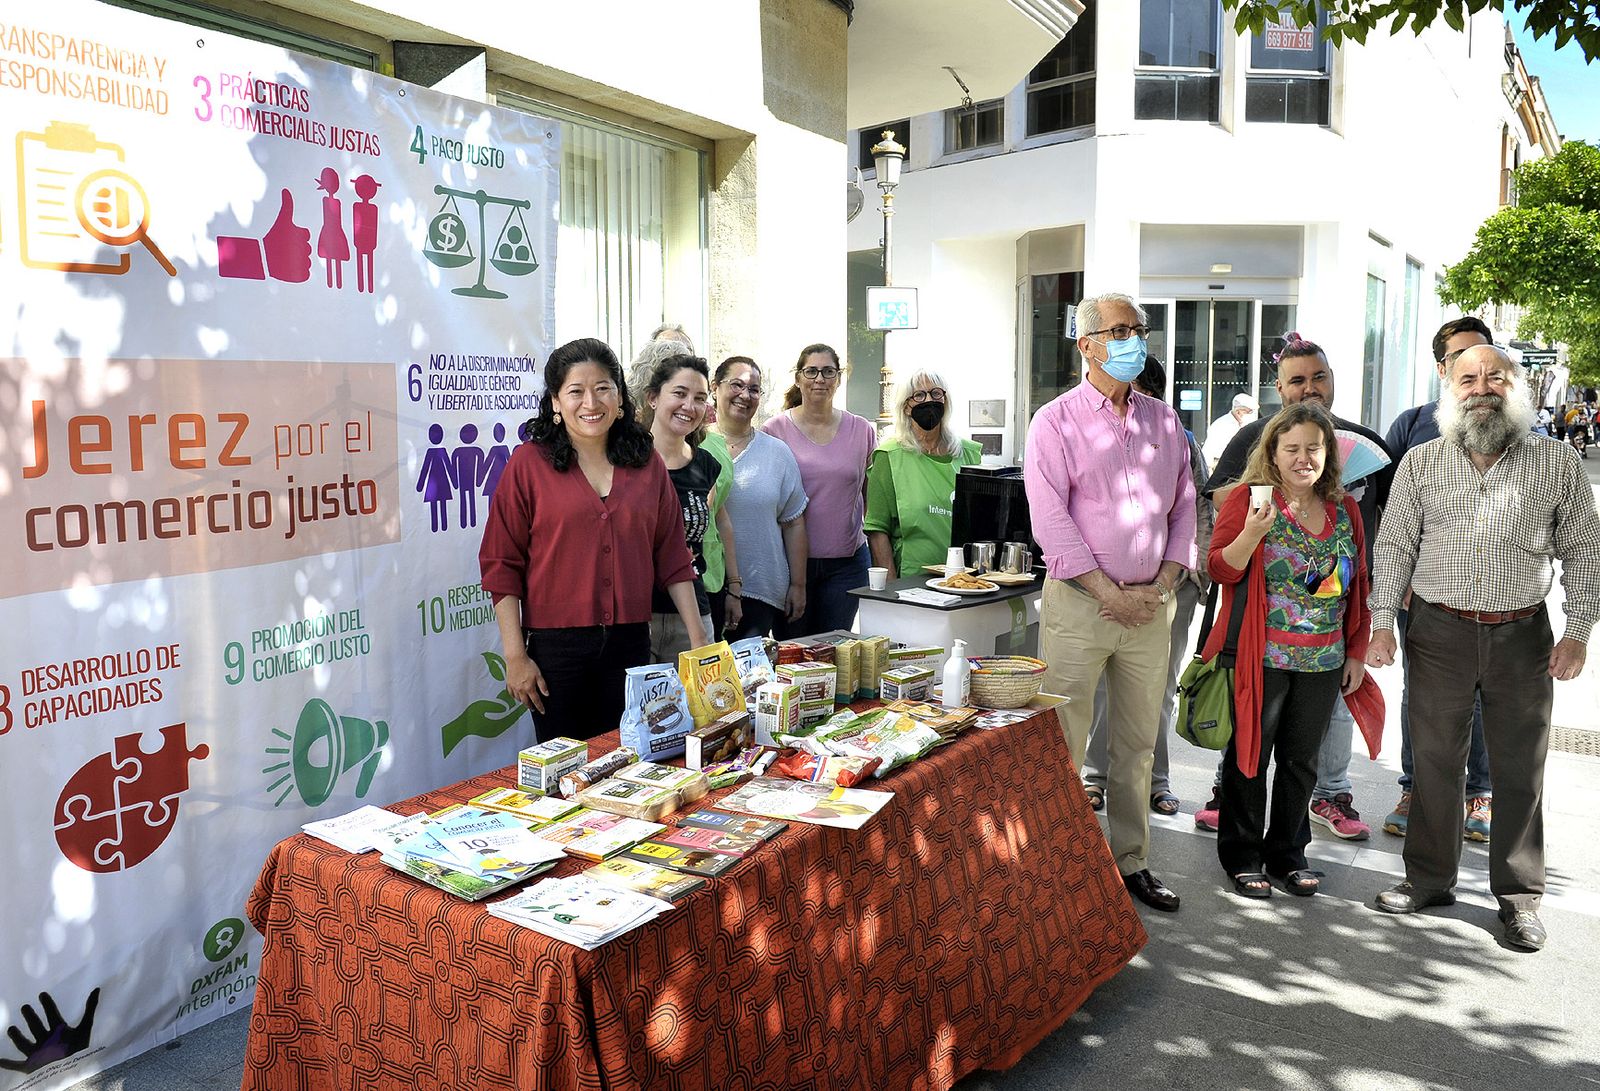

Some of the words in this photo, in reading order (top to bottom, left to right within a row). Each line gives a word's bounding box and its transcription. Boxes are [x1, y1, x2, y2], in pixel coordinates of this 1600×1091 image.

[1267, 31, 1281, 47] 669
[1282, 32, 1297, 48] 877
[1298, 33, 1312, 48] 514
[154, 56, 167, 82] Y
[193, 75, 213, 122] 3
[219, 72, 310, 113] PRÁCTICAS
[220, 104, 326, 147] COMERCIALES
[328, 126, 381, 157] JUSTAS
[410, 124, 428, 165] 4
[431, 135, 463, 162] PAGO
[465, 143, 505, 169] JUSTO
[407, 363, 423, 402] 6
[428, 374, 478, 391] IGUALDAD
[479, 375, 488, 391] DE
[489, 371, 521, 391] GÉNERO
[429, 354, 446, 371] NO
[447, 355, 456, 371] A
[457, 355, 468, 371] LA
[428, 394, 435, 410] Y
[437, 394, 483, 410] LIBERTAD
[484, 394, 493, 410] DE
[22, 399, 252, 479] Jerez
[274, 422, 330, 471] por
[345, 410, 373, 453] el
[25, 479, 273, 552] comercio
[284, 473, 378, 539] justo
[252, 609, 336, 654] PROMOCIÓN
[339, 608, 365, 633] DEL
[416, 596, 446, 637] 10
[21, 648, 151, 697] DESARROLLO
[156, 643, 181, 671] DE
[223, 641, 246, 686] 9
[252, 642, 325, 682] COMERCIO
[328, 633, 371, 663] JUSTO
[24, 677, 163, 729] CAPACIDADES
[443, 820, 487, 833] Conocer
[490, 817, 502, 825] el
[459, 838, 488, 851] 10
[190, 952, 249, 995] OXFAM
[175, 974, 257, 1019] Intermón
